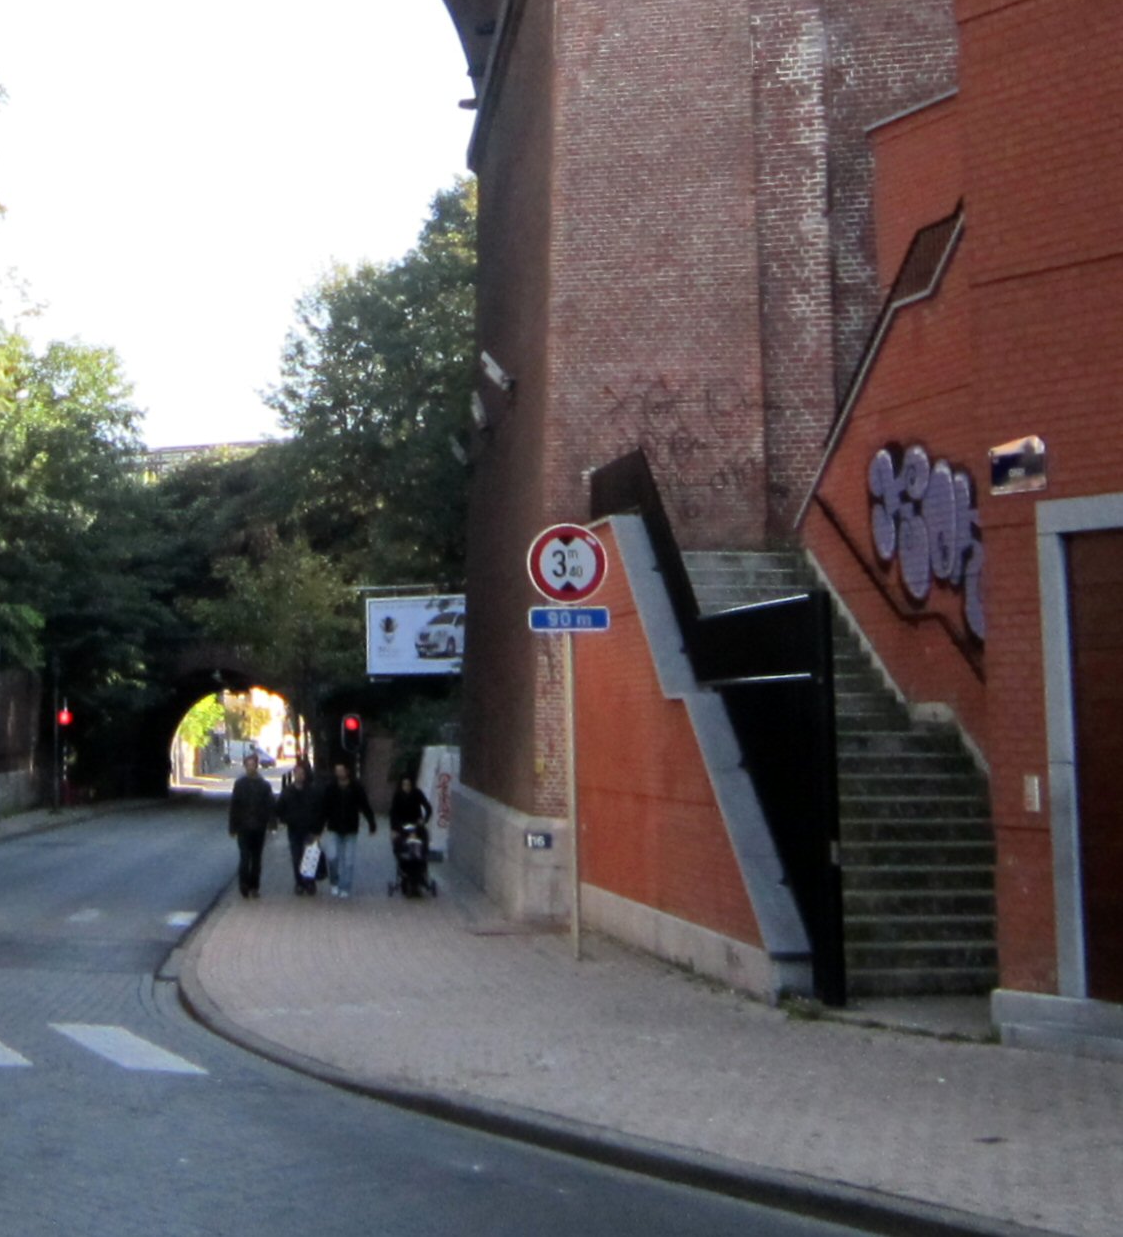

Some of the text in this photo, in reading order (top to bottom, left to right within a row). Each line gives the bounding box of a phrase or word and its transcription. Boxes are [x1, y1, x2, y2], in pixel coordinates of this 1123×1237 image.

[552, 549, 579, 577] 3 m
[569, 565, 584, 578] 40
[547, 611, 593, 628] 90 m
